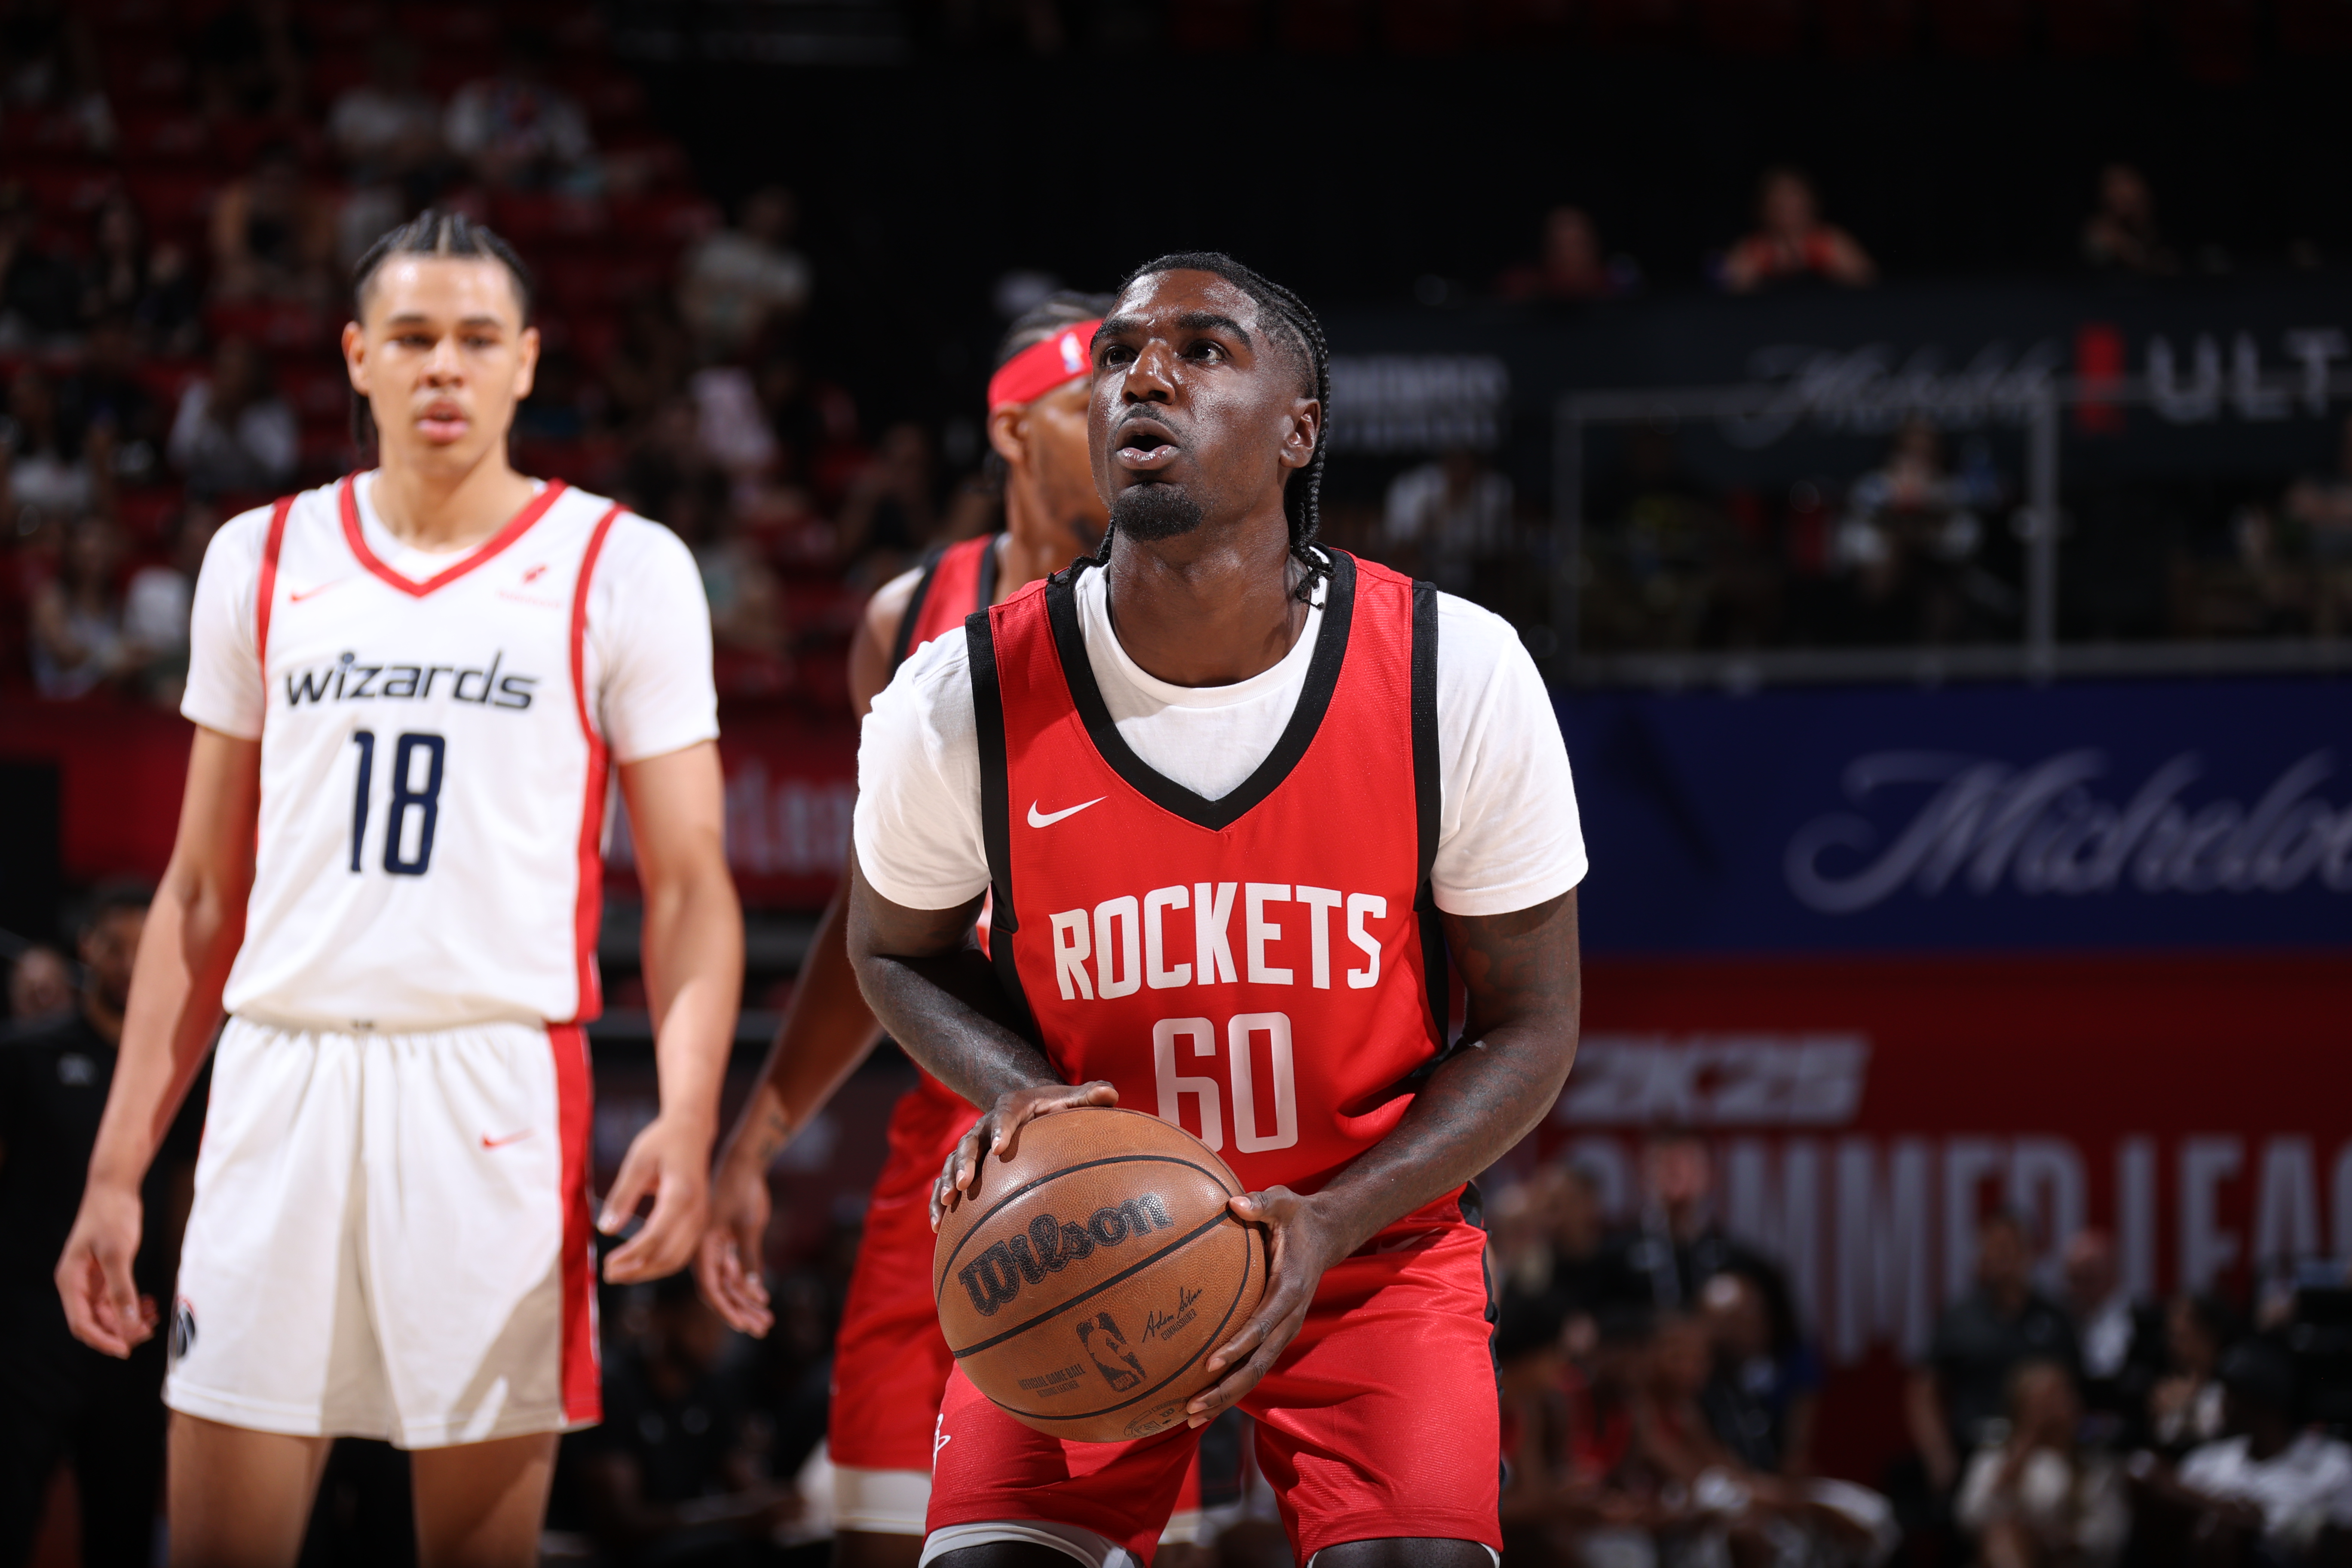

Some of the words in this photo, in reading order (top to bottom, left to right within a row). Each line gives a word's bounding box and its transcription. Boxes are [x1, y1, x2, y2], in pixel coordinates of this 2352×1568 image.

[285, 648, 542, 712] wizards
[349, 730, 446, 876] 18
[1049, 882, 1387, 1001] ROCKETS
[1152, 1011, 1298, 1155] 60
[958, 1192, 1174, 1316] Wilson
[2112, 1131, 2352, 1309] LEA
[1018, 1375, 1049, 1390] OFFICIAL
[1045, 1369, 1068, 1385] GAME
[1065, 1363, 1086, 1378] BALL
[1161, 1308, 1197, 1341] COMMISSIONER
[1036, 1386, 1059, 1398] GENUINE
[1057, 1380, 1080, 1393] LEATHER
